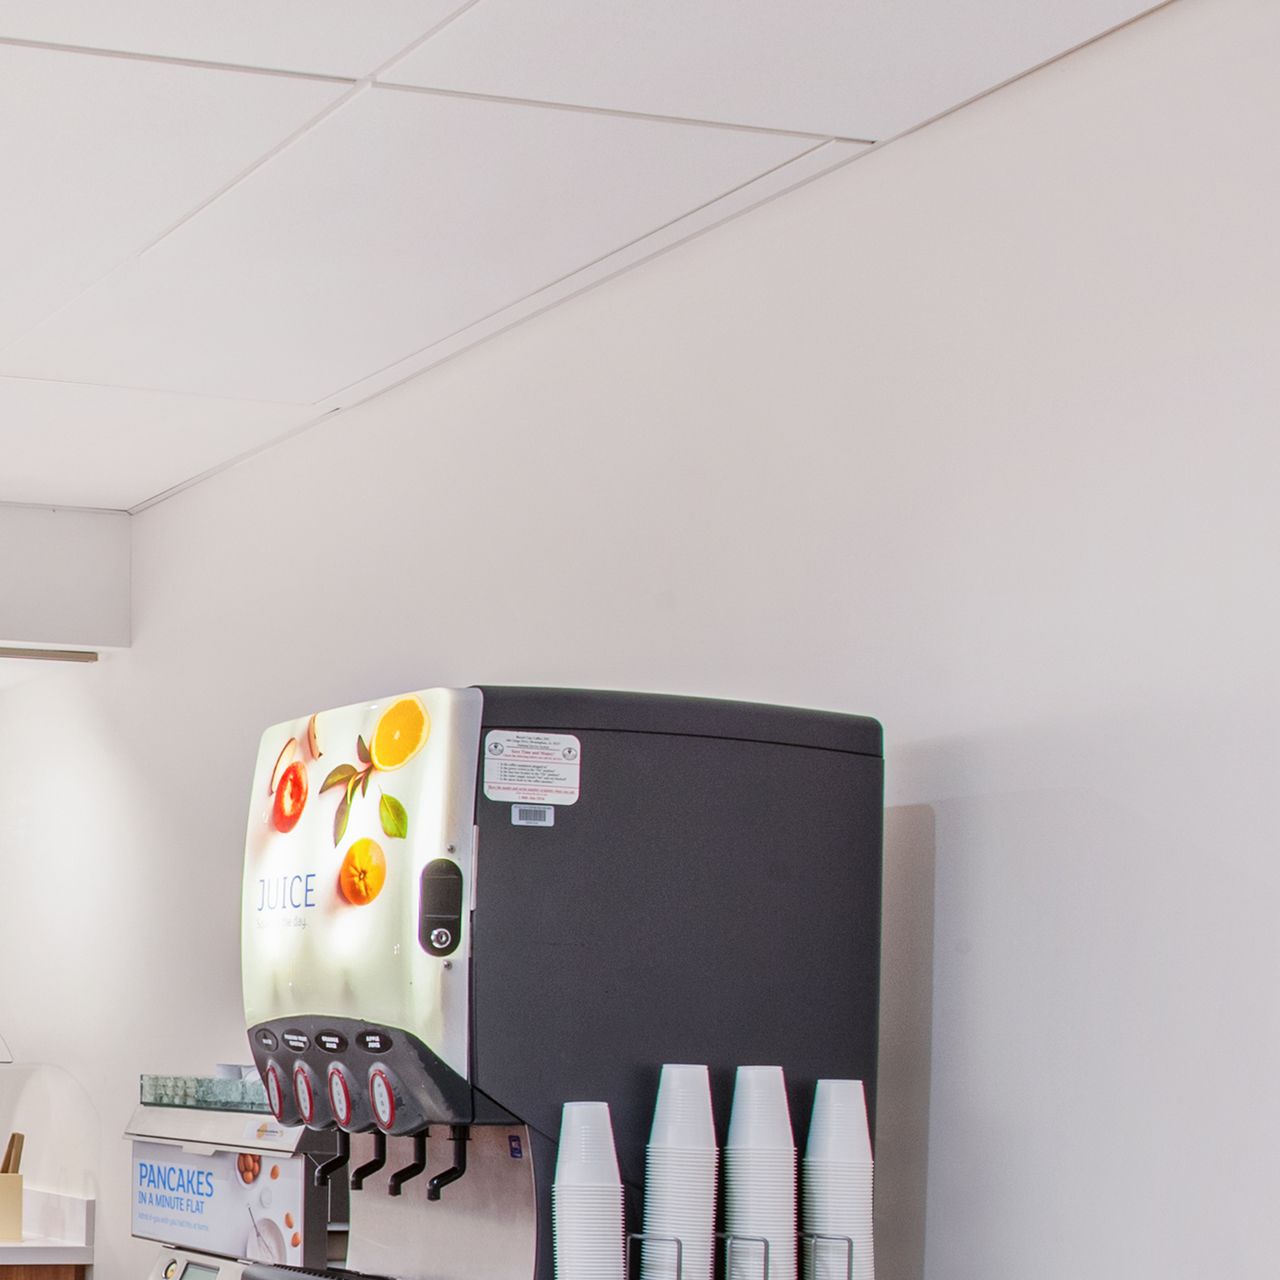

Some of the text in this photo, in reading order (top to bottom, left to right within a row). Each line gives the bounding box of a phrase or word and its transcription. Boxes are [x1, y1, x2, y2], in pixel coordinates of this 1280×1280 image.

[257, 874, 316, 911] JUICE
[138, 1163, 214, 1198] PANCAKES
[138, 1191, 205, 1214] IN A MINUTE FLAT
